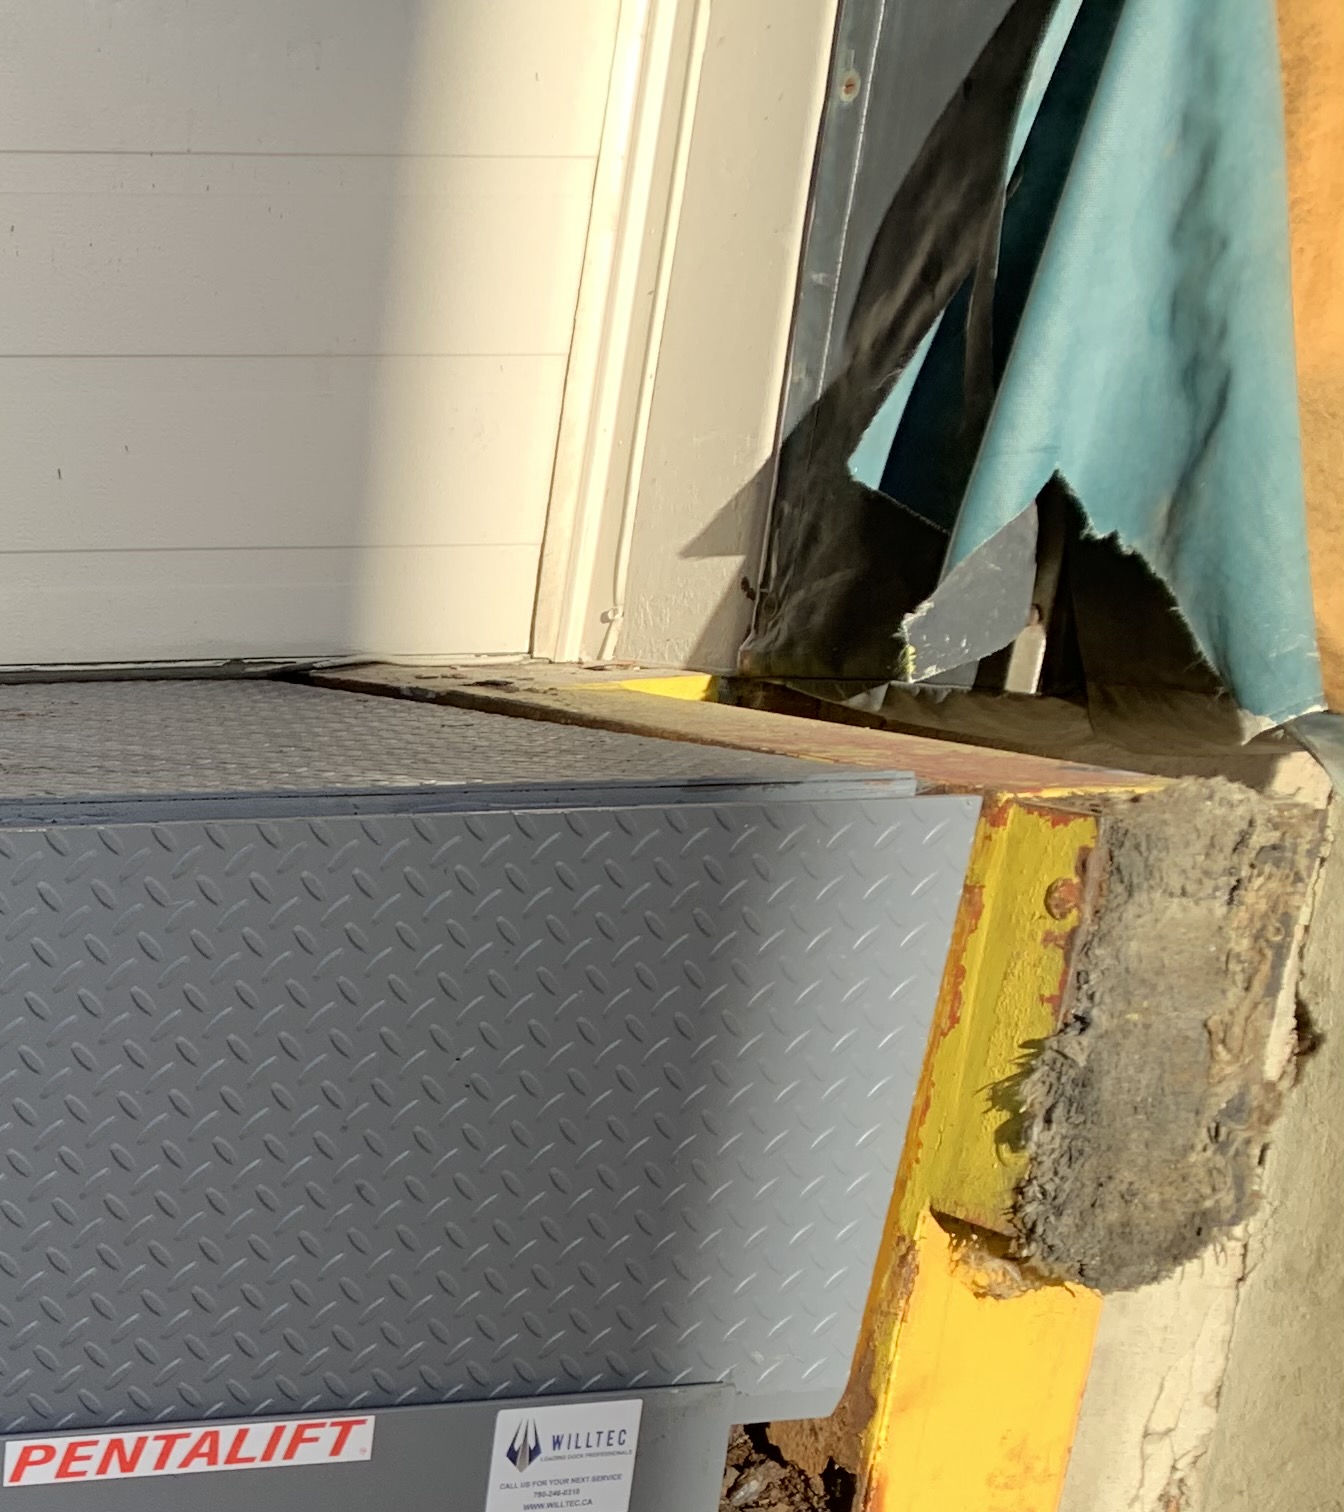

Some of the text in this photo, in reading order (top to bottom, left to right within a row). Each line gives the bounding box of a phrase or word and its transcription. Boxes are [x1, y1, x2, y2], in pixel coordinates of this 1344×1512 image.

[552, 1429, 627, 1451] WILLTEC
[9, 1418, 367, 1483] PENTALIFT
[540, 1454, 566, 1462] LOADING
[585, 1449, 632, 1459] PROFESSIONALS
[500, 1481, 518, 1490] CALL
[532, 1479, 547, 1487] FOR
[549, 1478, 570, 1486] YOUR
[571, 1476, 591, 1485] NEXT
[592, 1473, 623, 1483] SERVICE
[523, 1498, 593, 1511] WWW.WILLTEC.CA
